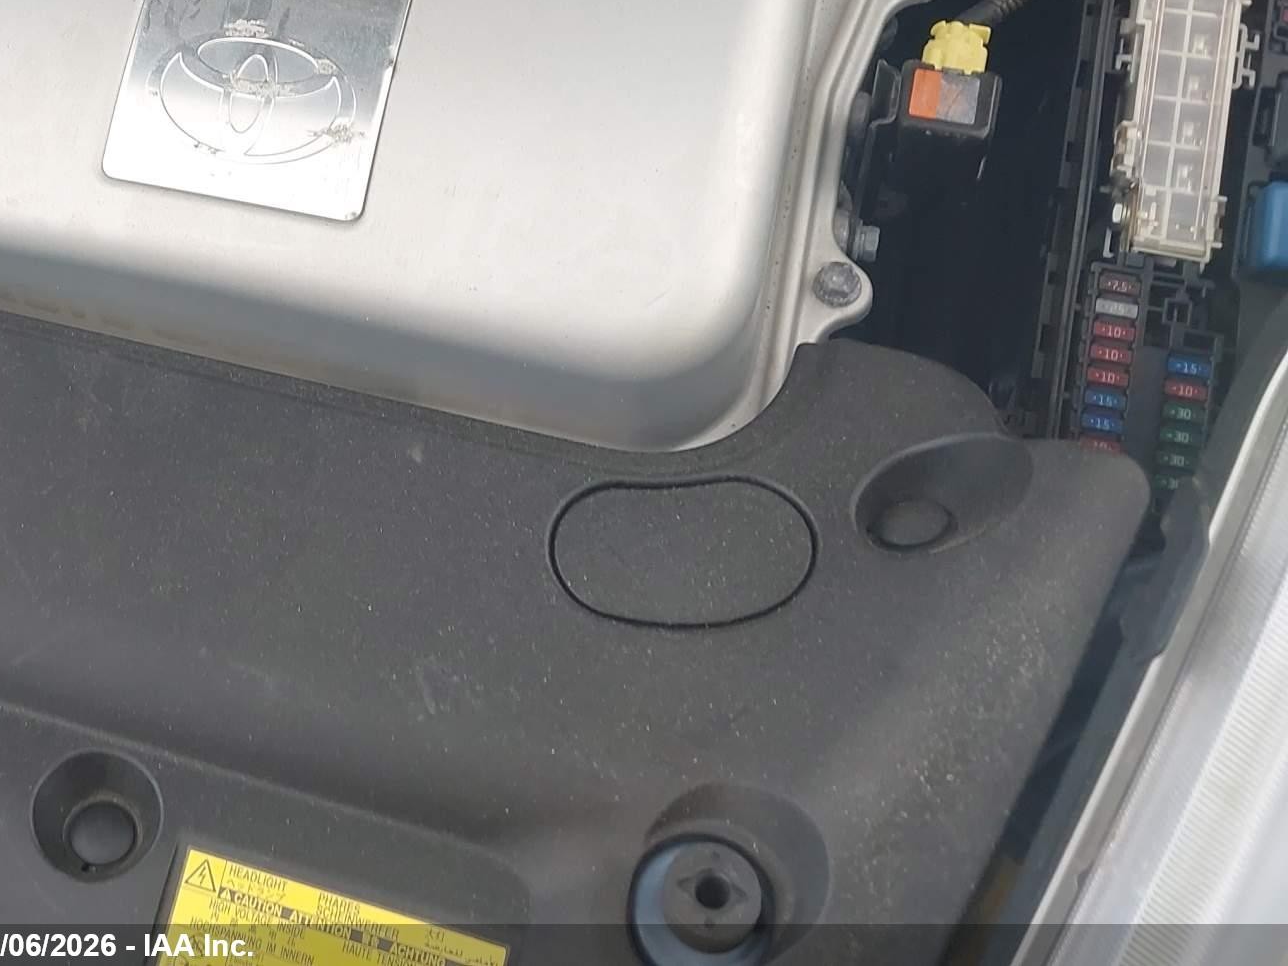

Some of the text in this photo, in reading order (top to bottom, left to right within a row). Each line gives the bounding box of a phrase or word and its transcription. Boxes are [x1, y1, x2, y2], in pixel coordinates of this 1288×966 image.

[1107, 326, 1121, 338] 10
[1104, 348, 1119, 360] 10
[1184, 363, 1197, 375] 15
[1101, 371, 1115, 383] 10
[1179, 386, 1193, 397] 10
[1099, 394, 1112, 406] 15
[1176, 407, 1191, 420] 30
[1096, 416, 1109, 428] 15
[1174, 432, 1189, 443] 30
[1169, 455, 1184, 467] 30
[229, 863, 288, 891] HEADLIGHT
[318, 892, 360, 915] PHARES
[209, 897, 231, 915] HIGH
[234, 905, 271, 928] VOLTAGE
[276, 920, 305, 940] INSIDE
[316, 904, 400, 939] SCHEINWERFER
[233, 892, 283, 917] CAUTION
[288, 908, 352, 941] ATTENTION
[389, 944, 446, 966] ACHTUNG
[189, 916, 263, 951] HOCHSPANNUNG
[265, 941, 277, 954] IM
[280, 945, 315, 965] INNERN
[342, 939, 372, 960] HAUTE
